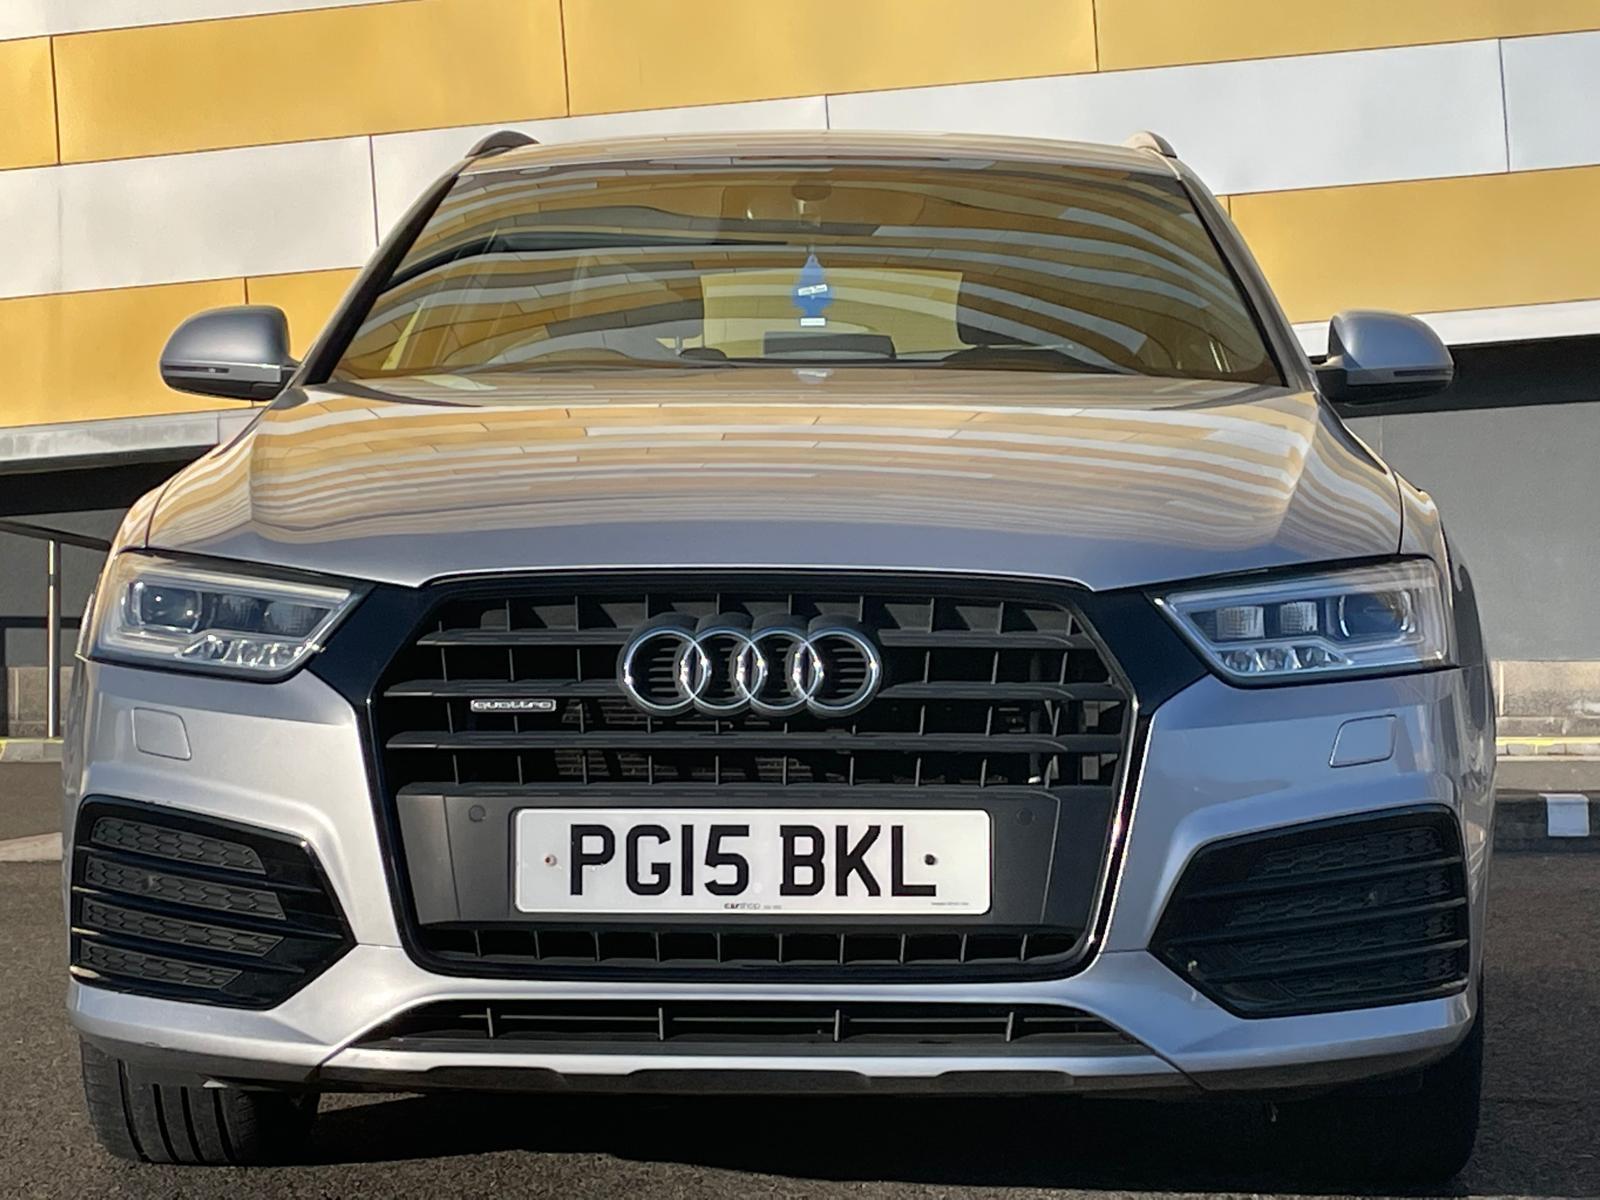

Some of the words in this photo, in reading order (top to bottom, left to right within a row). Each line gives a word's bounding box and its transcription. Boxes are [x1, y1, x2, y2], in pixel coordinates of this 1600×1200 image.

[472, 700, 554, 711] quattro
[570, 824, 750, 896] PG15
[780, 824, 937, 897] BKL
